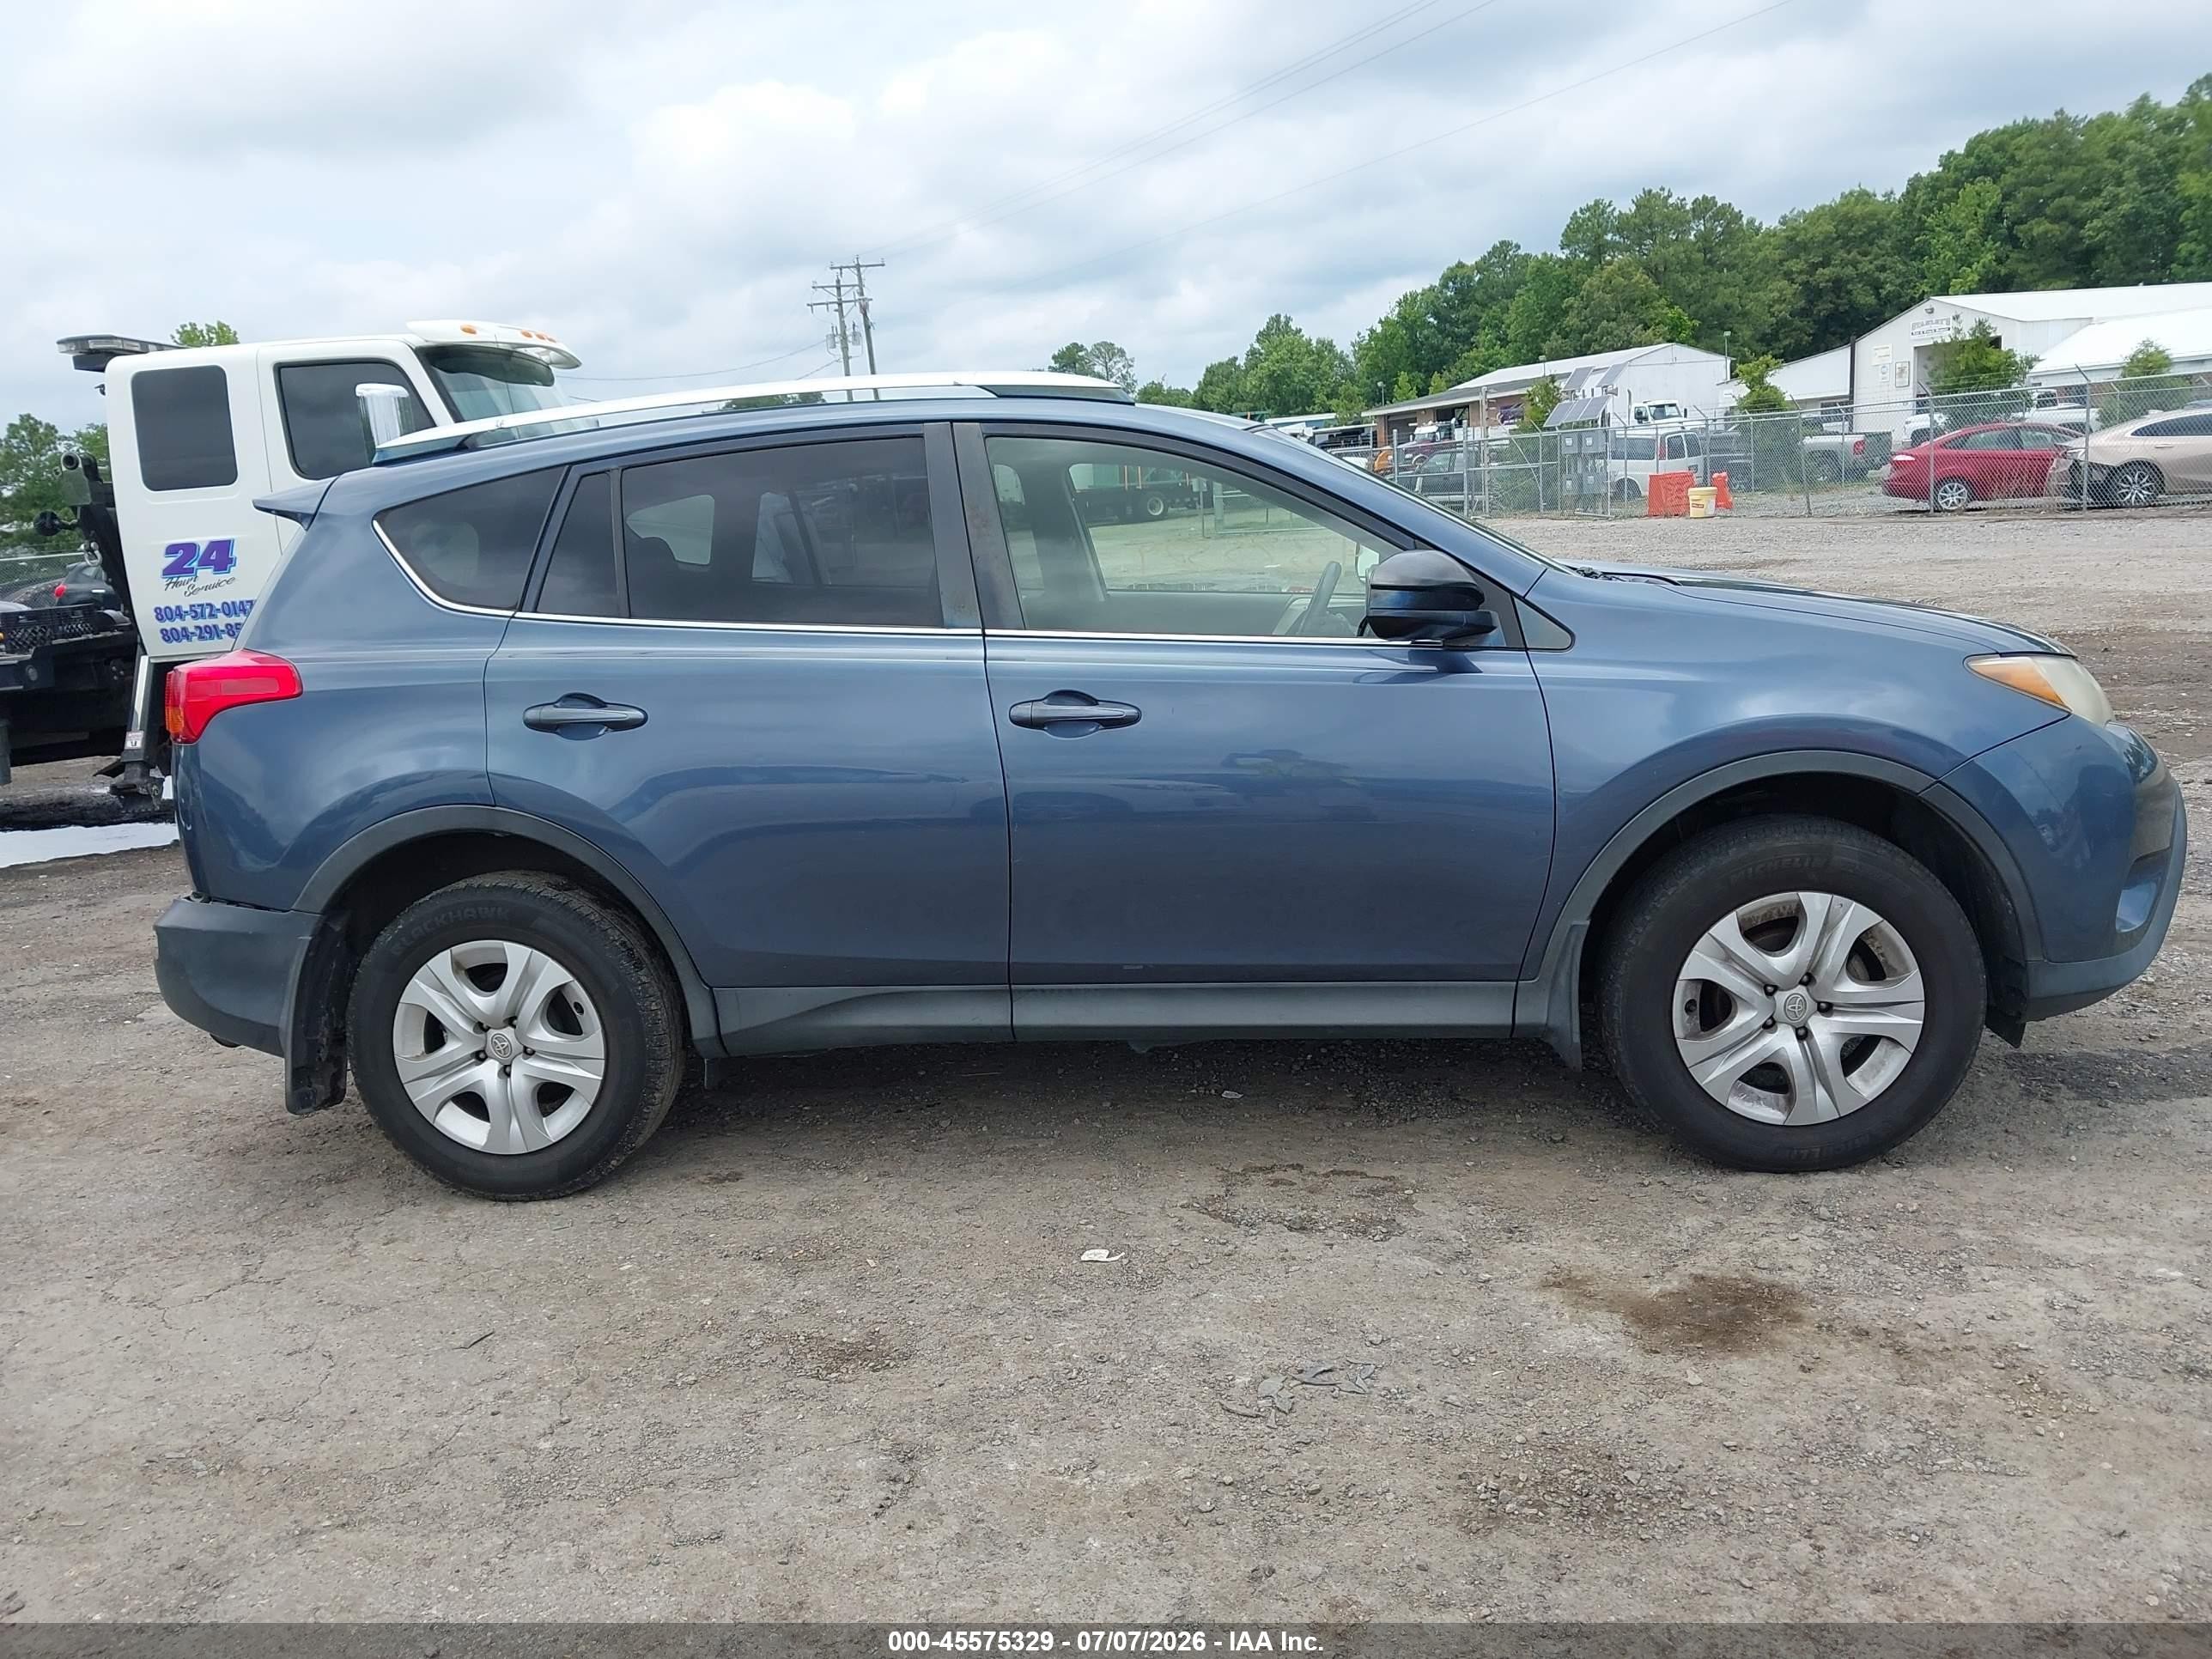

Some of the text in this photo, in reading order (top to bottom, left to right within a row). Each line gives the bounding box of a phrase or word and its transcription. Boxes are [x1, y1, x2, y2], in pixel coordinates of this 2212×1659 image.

[161, 539, 236, 579] 24
[164, 575, 198, 592] Hour
[184, 577, 235, 597] Service
[154, 599, 257, 623] 804-572-0147
